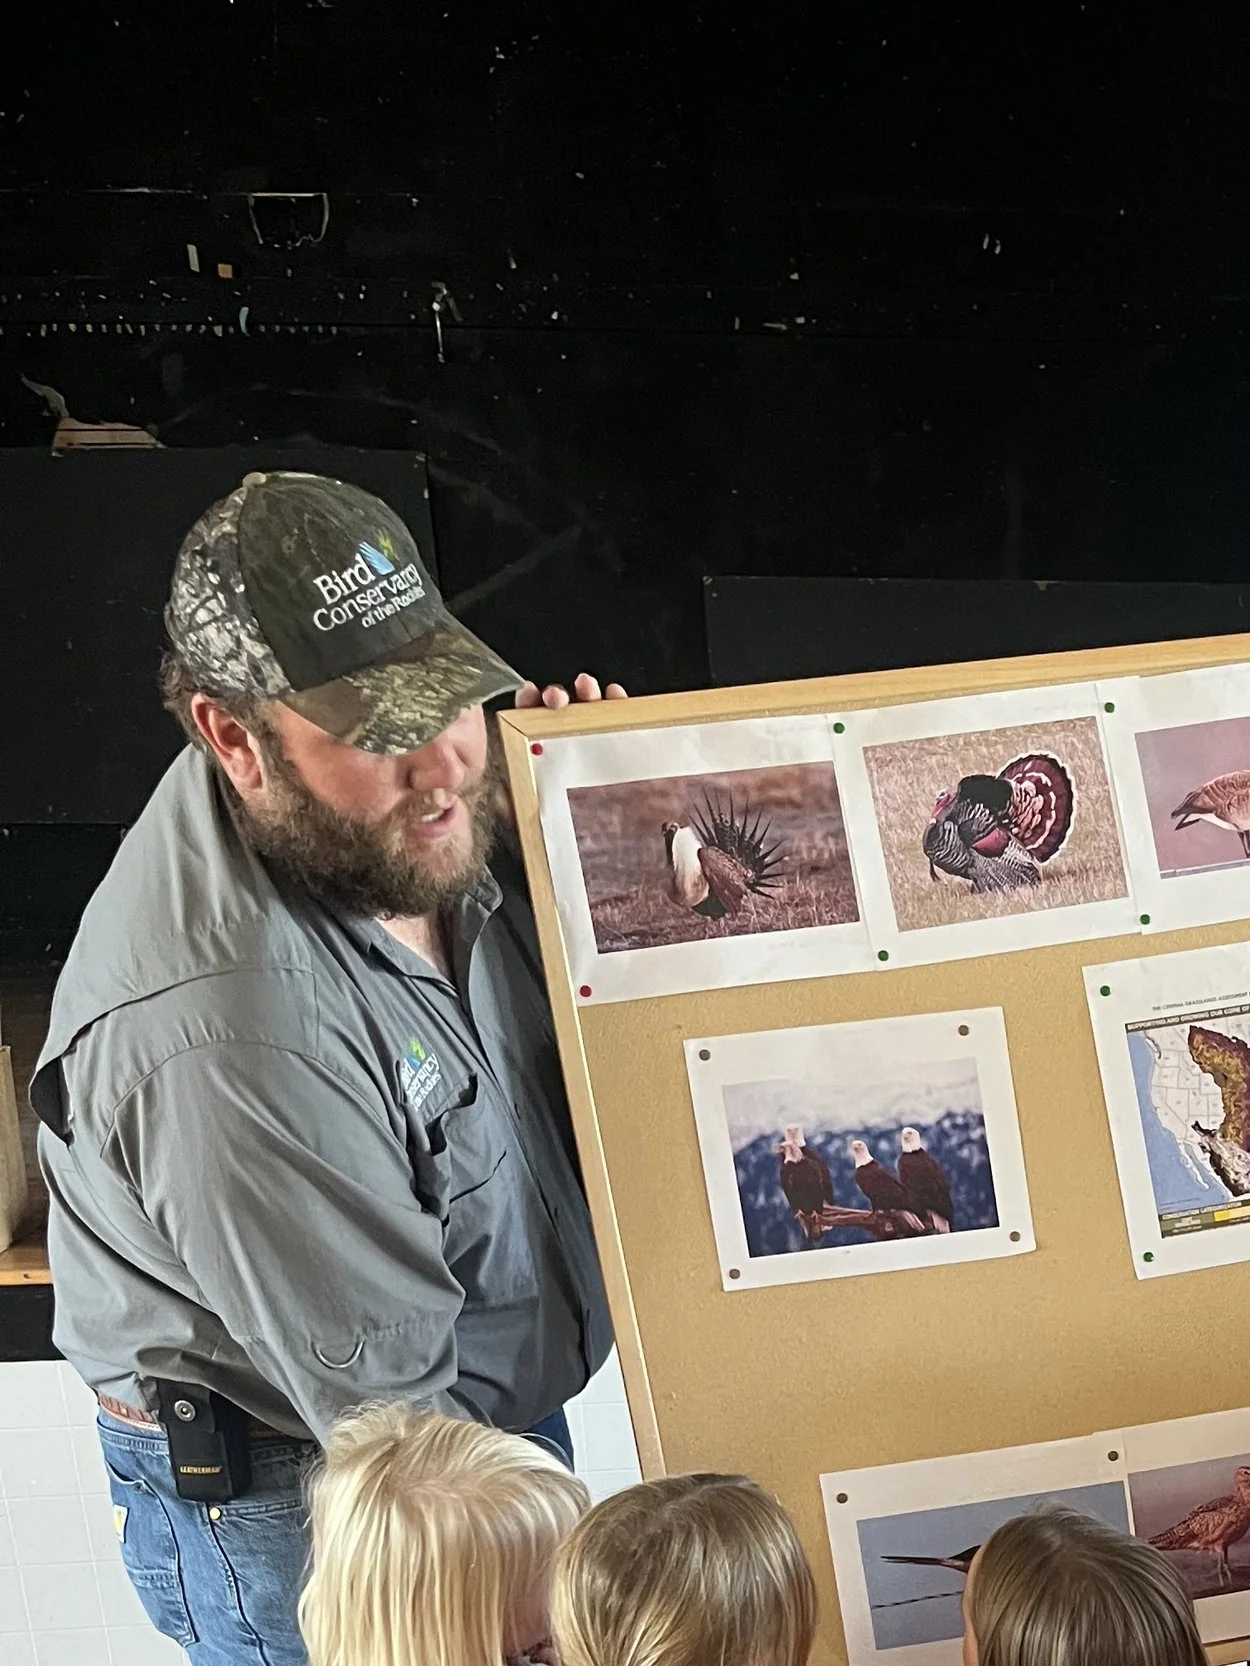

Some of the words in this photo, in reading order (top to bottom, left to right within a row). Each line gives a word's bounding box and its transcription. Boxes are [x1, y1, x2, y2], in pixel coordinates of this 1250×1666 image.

[313, 553, 376, 605] Bird
[313, 563, 423, 631] Conservancy
[362, 611, 376, 628] of
